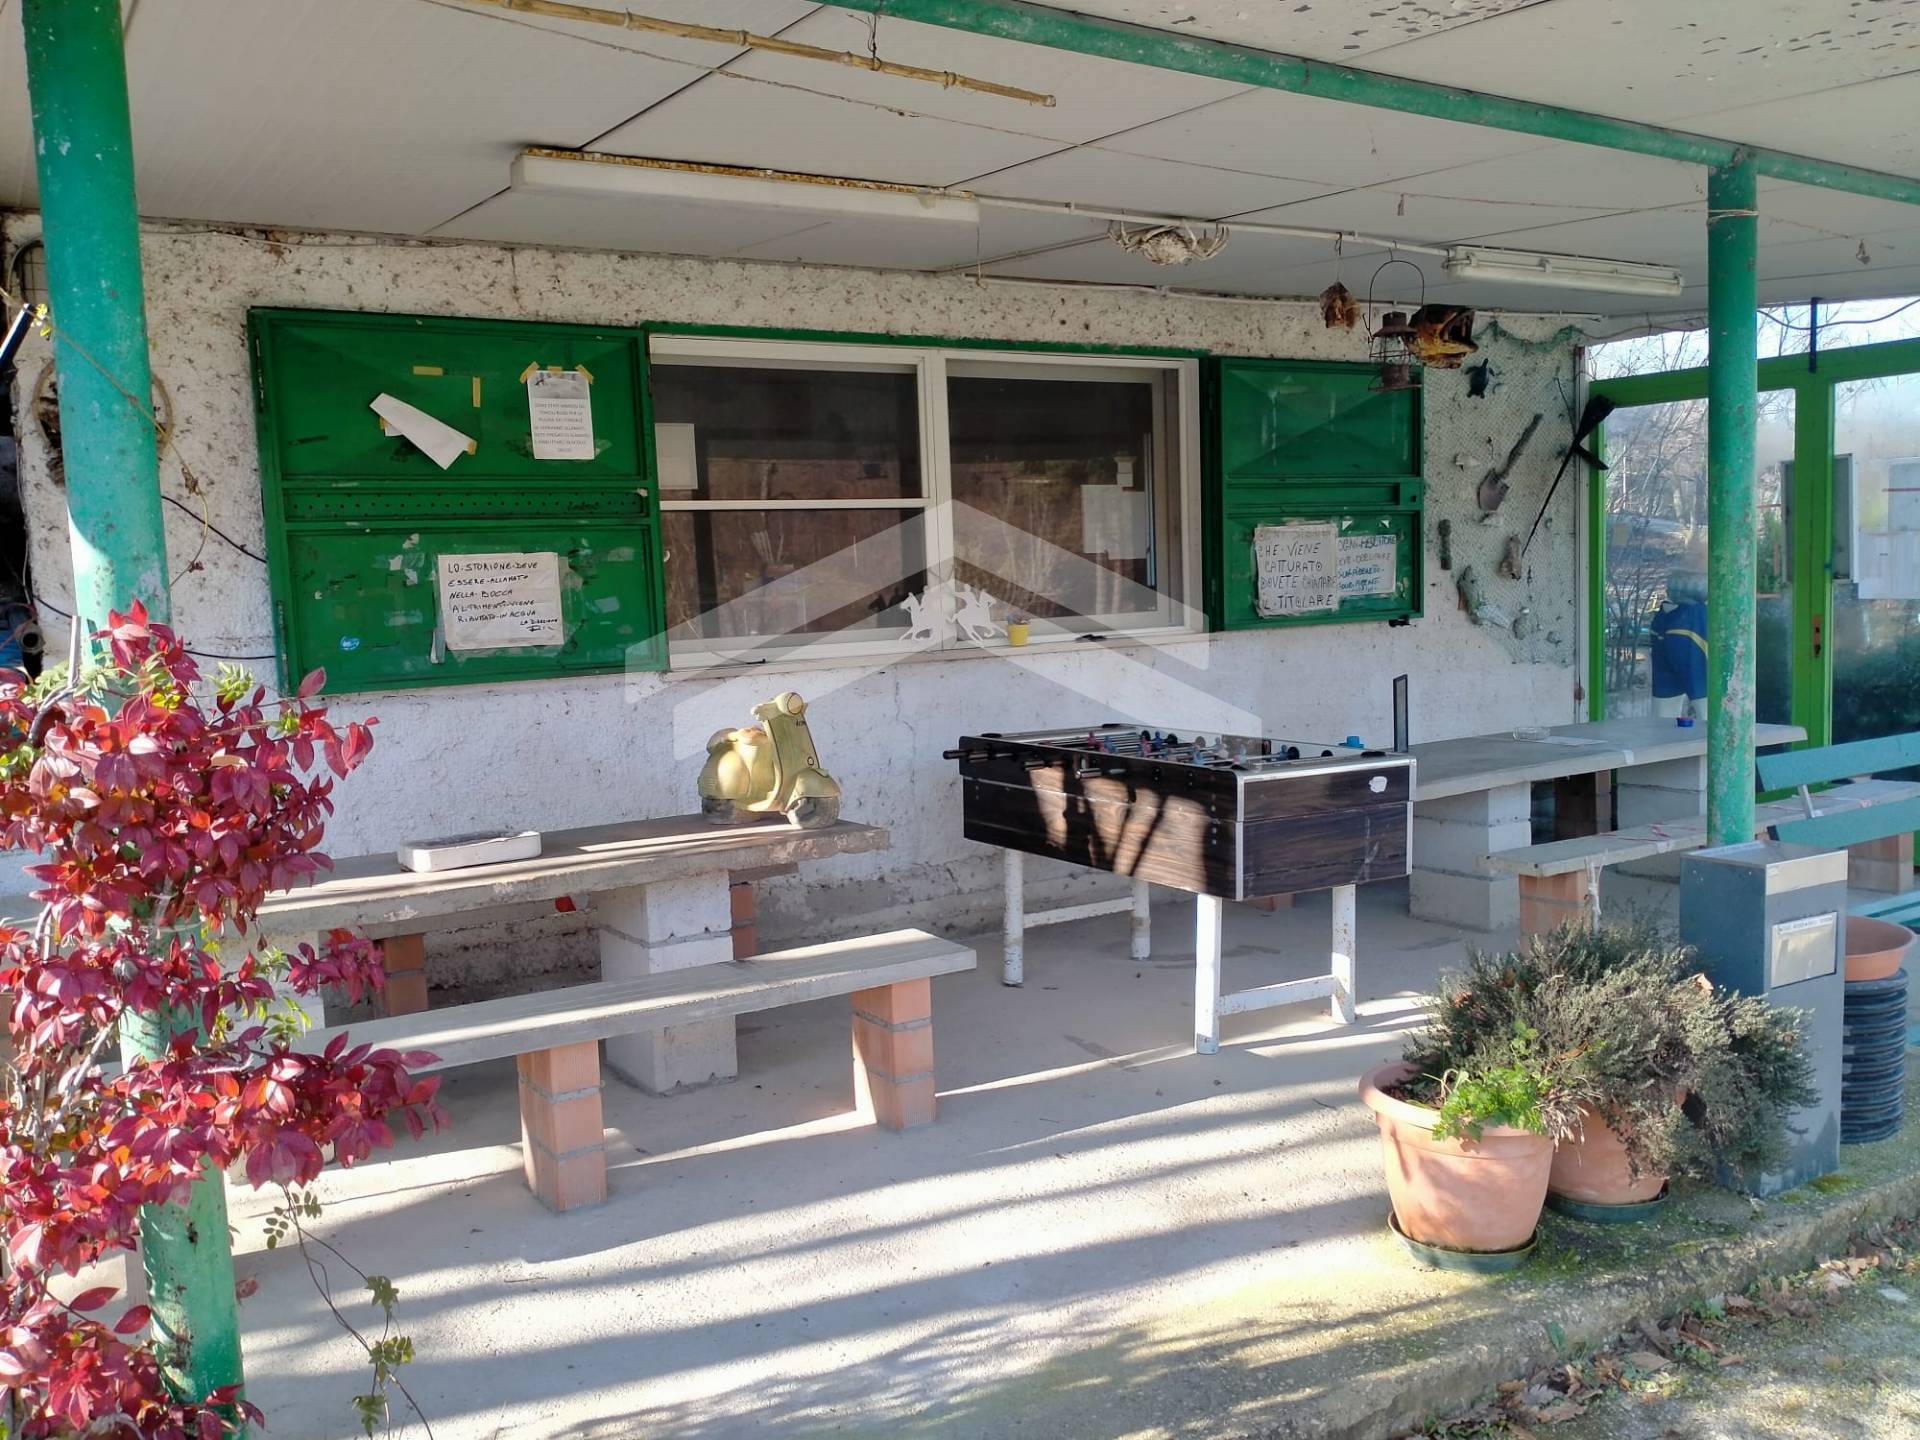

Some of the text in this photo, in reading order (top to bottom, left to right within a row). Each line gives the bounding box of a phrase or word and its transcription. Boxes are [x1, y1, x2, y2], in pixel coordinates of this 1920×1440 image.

[1287, 541, 1321, 557] VIENE
[1265, 560, 1323, 573] CATTURATO
[482, 589, 513, 598] BOCCA
